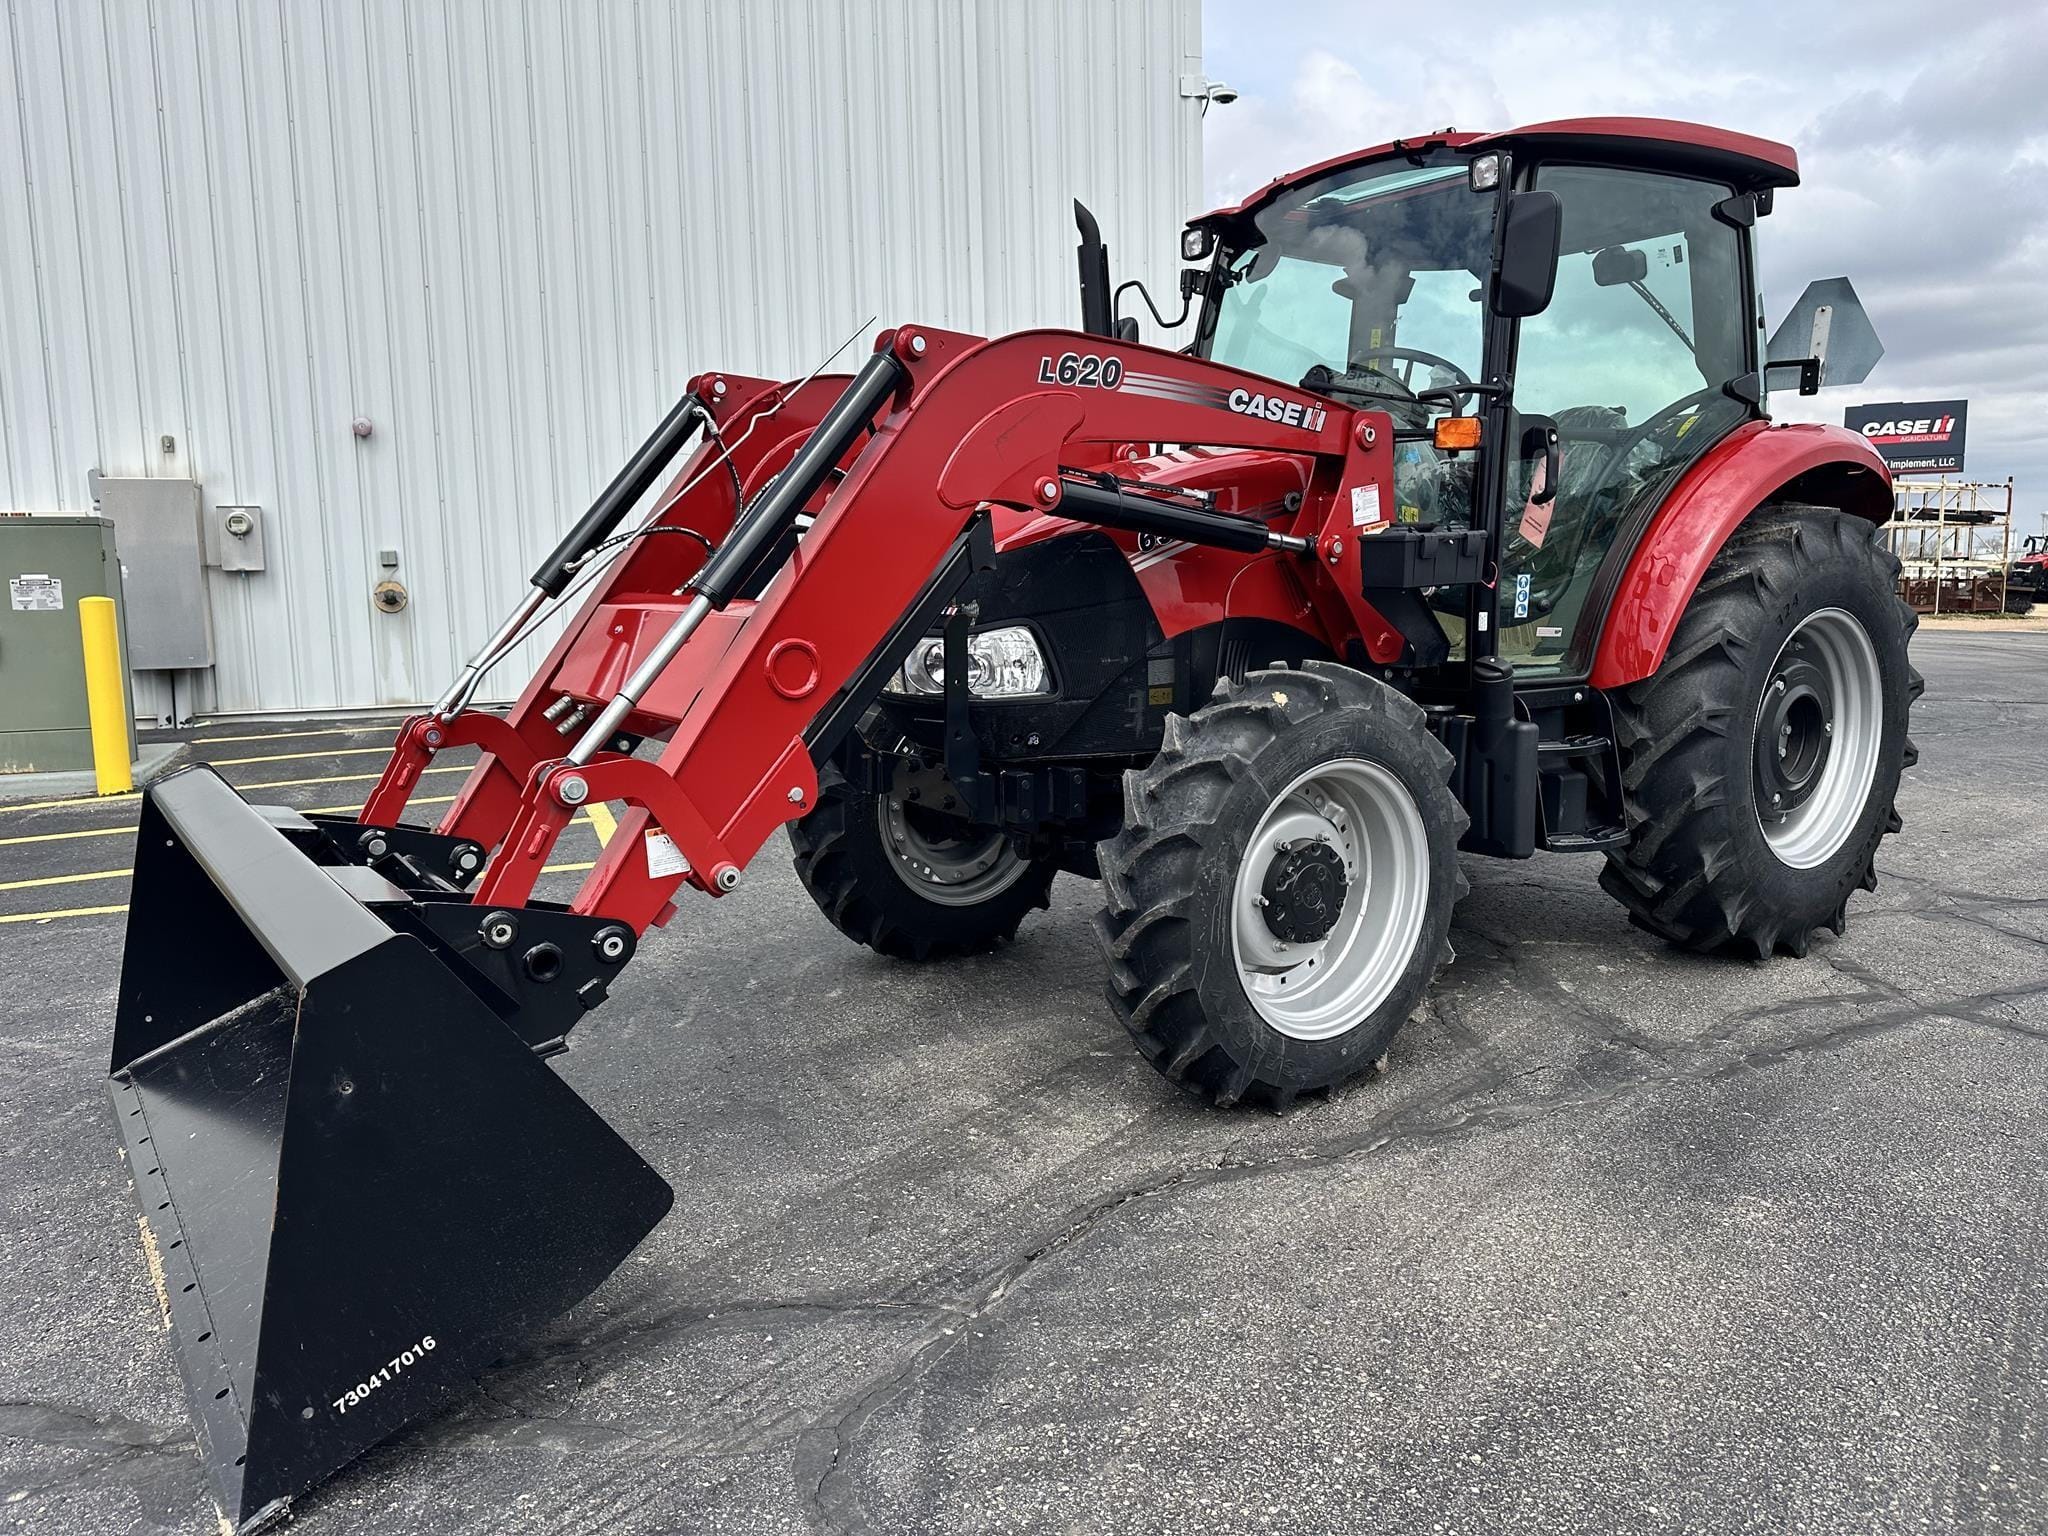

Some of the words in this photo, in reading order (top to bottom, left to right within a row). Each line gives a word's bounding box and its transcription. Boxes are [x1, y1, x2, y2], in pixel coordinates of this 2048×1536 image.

[1038, 352, 1123, 389] L620
[1228, 389, 1300, 425] CASE
[1863, 420, 1931, 436] CASE
[1900, 434, 1947, 442] AGRICULTURE
[1890, 458, 1937, 470] Implement,
[1939, 457, 1955, 467] LLC
[332, 1335, 436, 1414] 730417016
